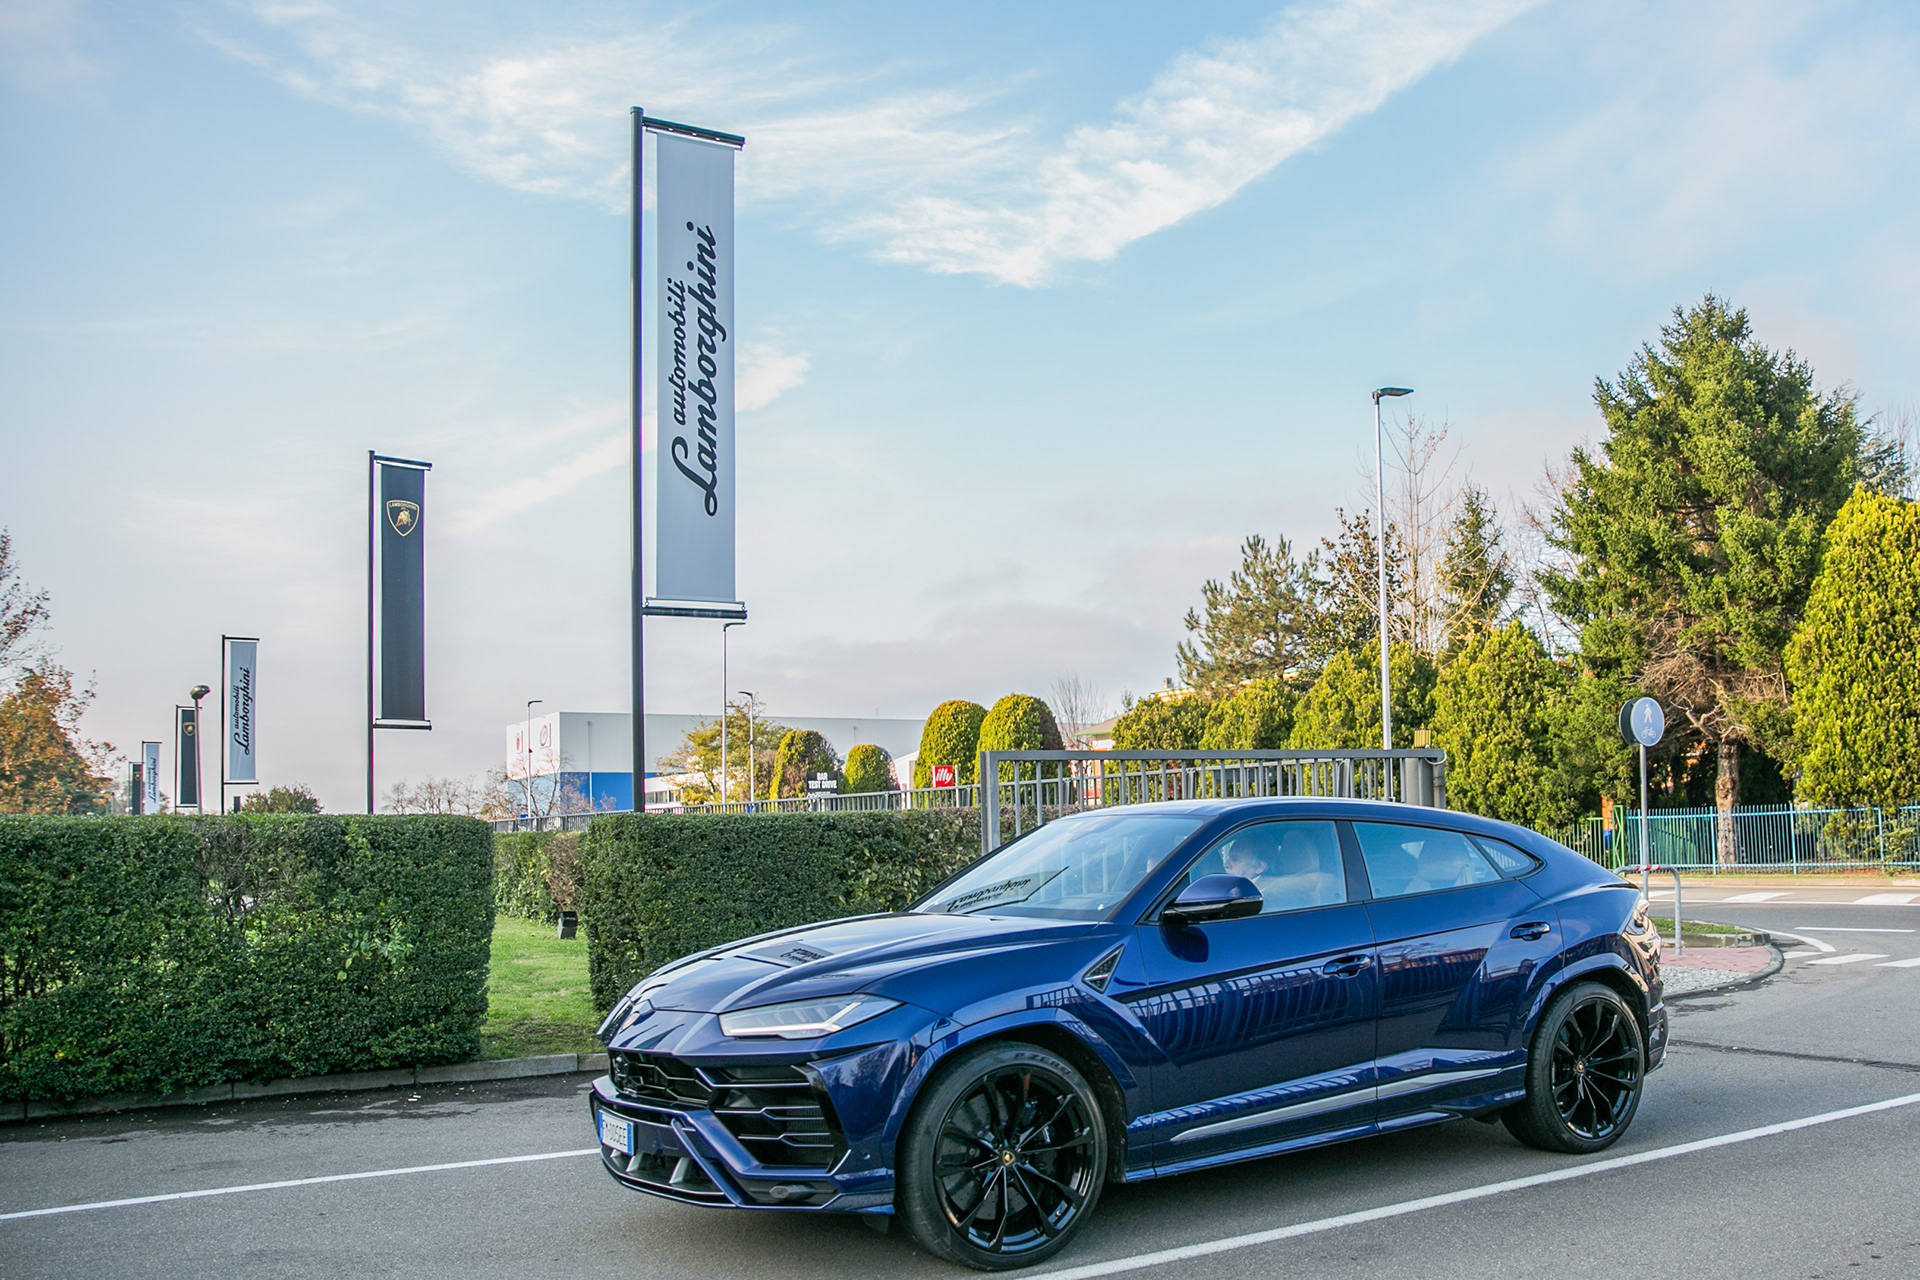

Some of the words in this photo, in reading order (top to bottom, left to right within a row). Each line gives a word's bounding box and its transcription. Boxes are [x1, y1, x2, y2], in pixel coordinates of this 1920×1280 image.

[667, 277, 687, 426] automobili
[671, 221, 727, 517] Lamborghini
[232, 685, 240, 729] automobili
[233, 667, 254, 755] Lamborghini
[808, 780, 821, 789] TEST
[816, 772, 828, 780] BAR
[935, 768, 953, 784] illy
[1028, 1053, 1071, 1075] ZERO
